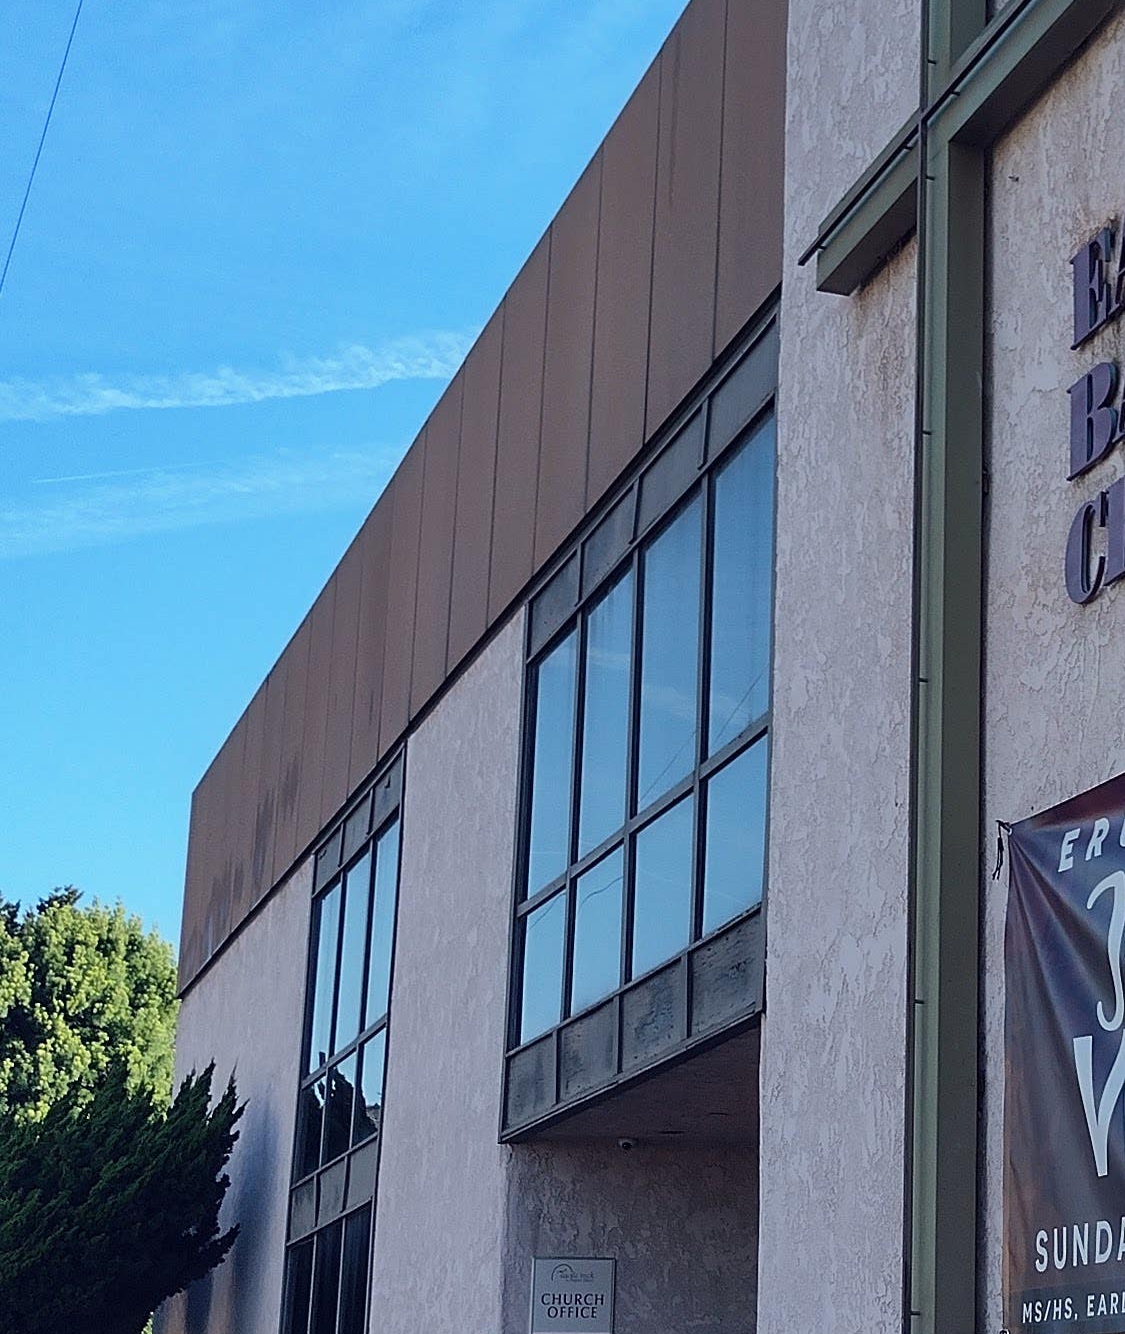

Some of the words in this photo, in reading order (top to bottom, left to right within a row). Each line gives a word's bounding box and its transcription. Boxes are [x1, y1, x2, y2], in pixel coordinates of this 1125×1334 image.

[541, 1292, 605, 1306] CHURCH
[547, 1306, 598, 1319] OFFICE
[1021, 1299, 1079, 1325] MS/HS,
